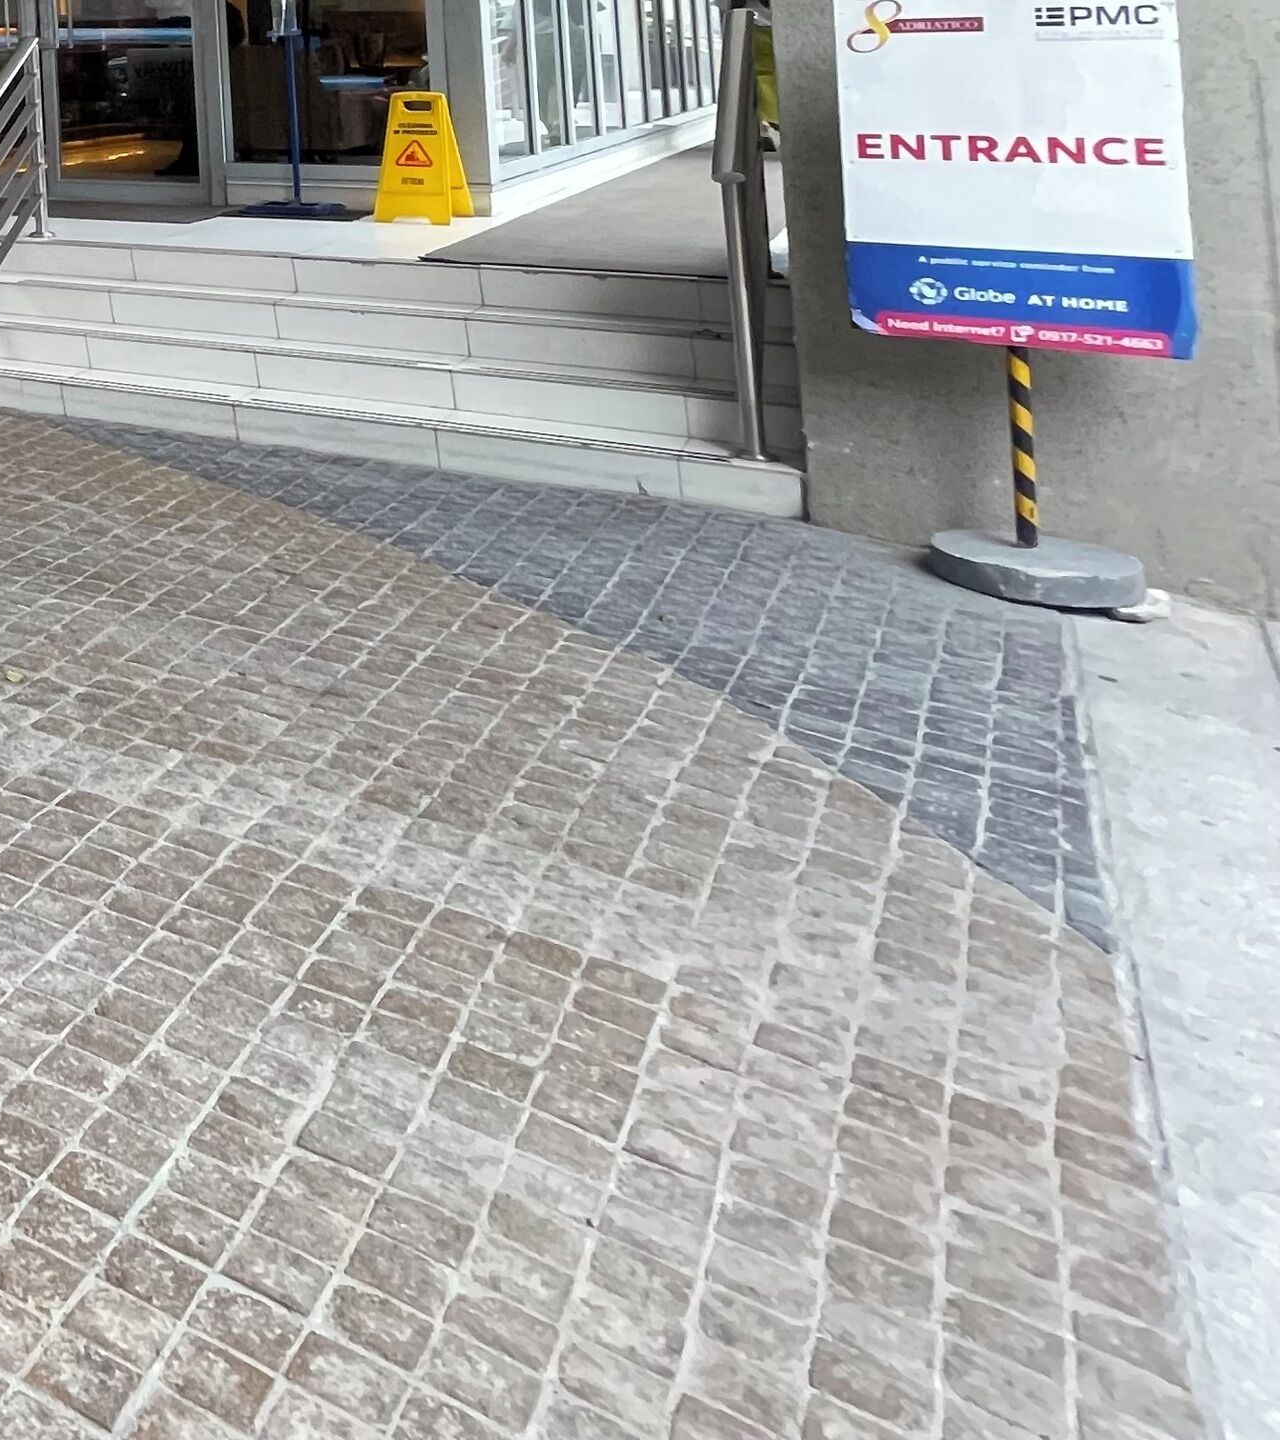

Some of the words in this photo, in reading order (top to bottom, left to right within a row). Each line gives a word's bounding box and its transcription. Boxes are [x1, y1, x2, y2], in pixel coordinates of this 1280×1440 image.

[897, 20, 980, 31] ADRIATICO
[856, 133, 1167, 167] ENTRANCE
[953, 286, 1017, 304] Globe
[1027, 294, 1056, 308] AT
[1061, 296, 1129, 313] HOME
[886, 317, 930, 332] Need
